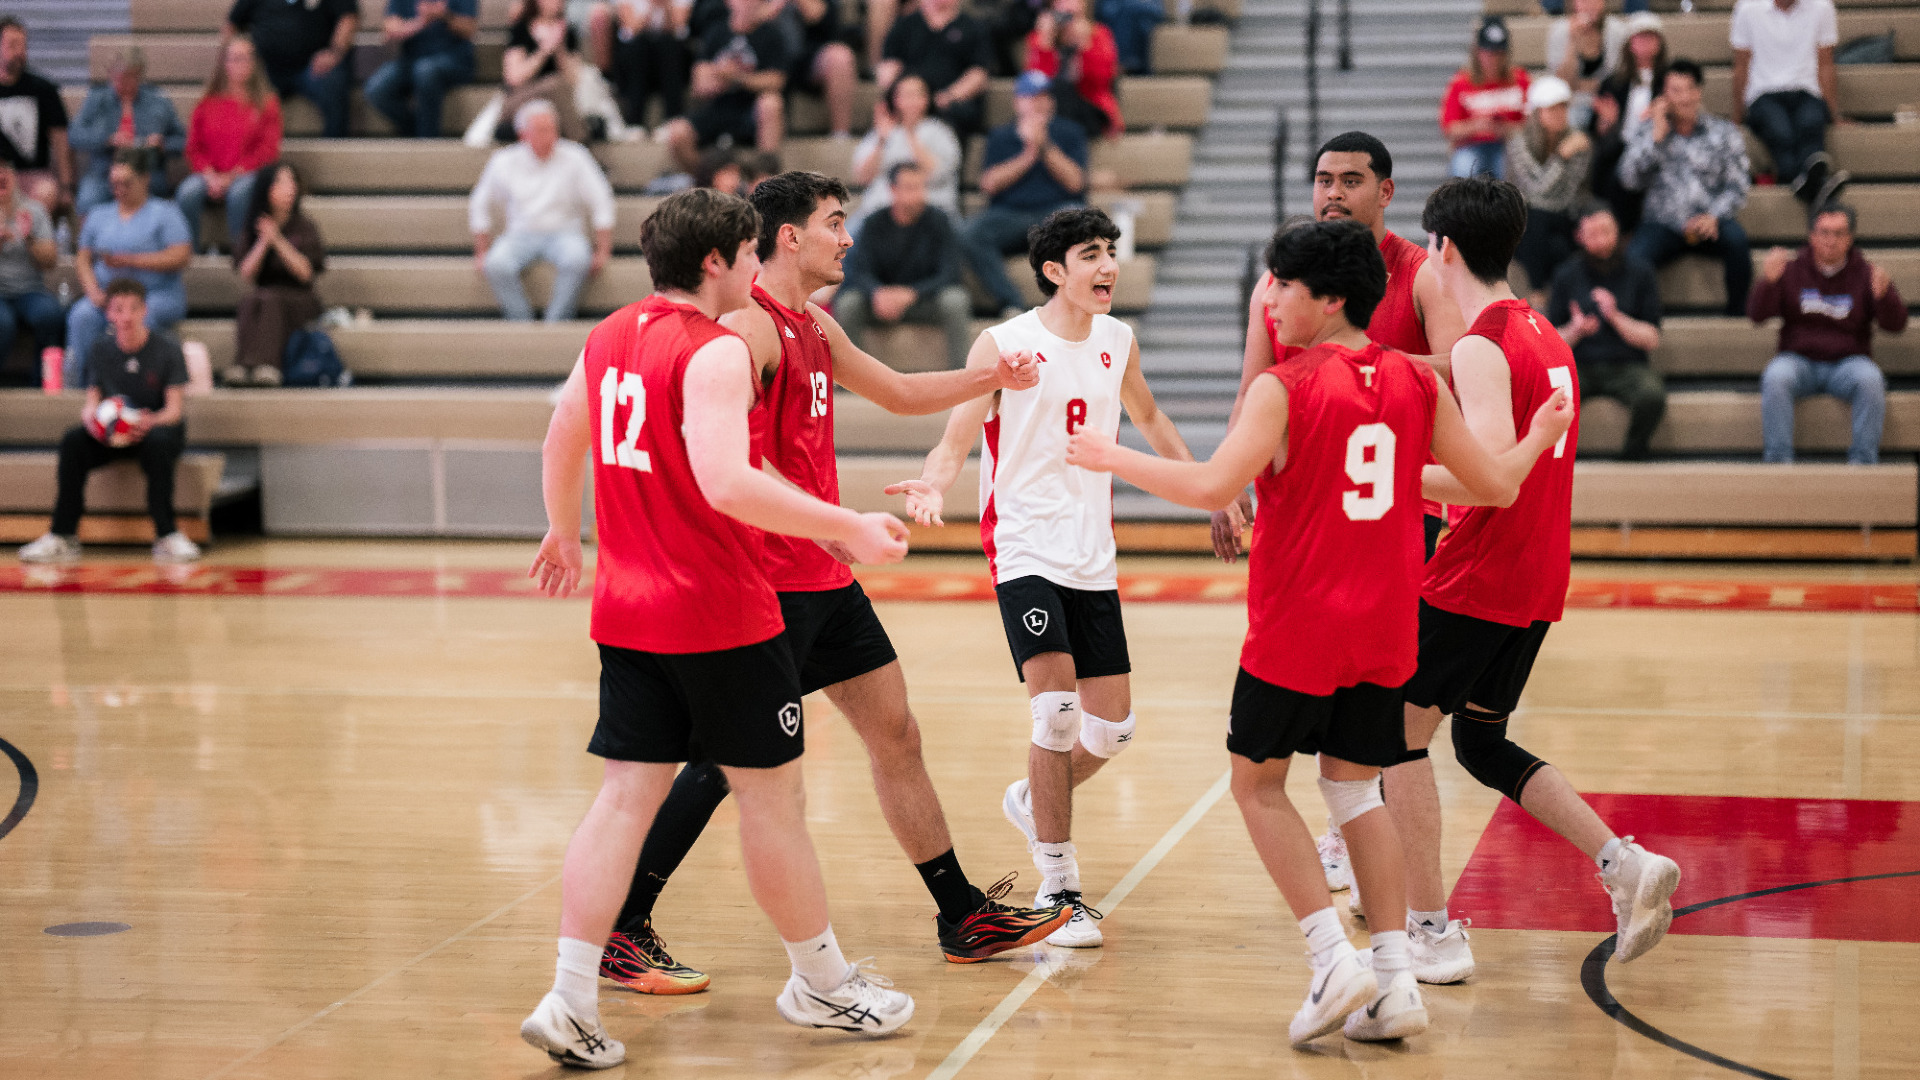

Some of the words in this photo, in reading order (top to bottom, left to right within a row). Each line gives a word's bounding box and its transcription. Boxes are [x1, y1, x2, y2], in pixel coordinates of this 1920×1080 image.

[810, 371, 828, 417] 13
[599, 366, 653, 474] 12
[1066, 398, 1087, 436] 8
[1342, 422, 1396, 521] 9
[1030, 614, 1043, 628] L
[785, 710, 797, 727] L
